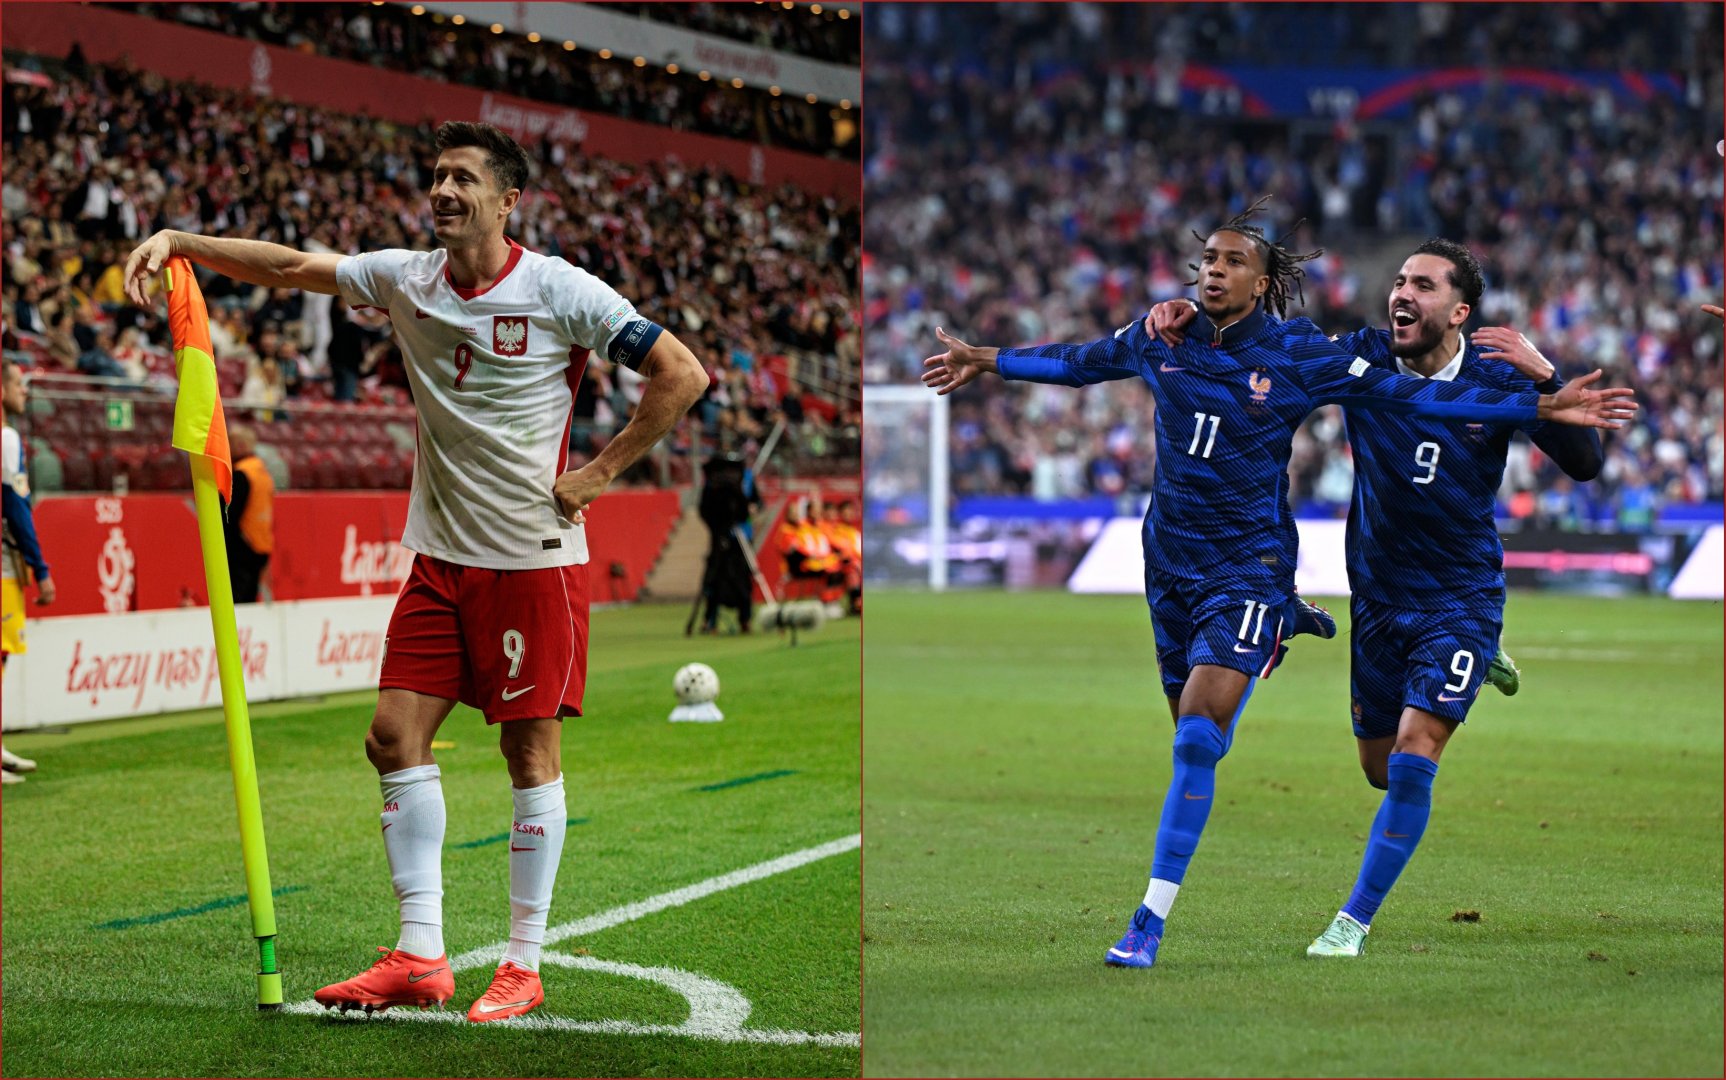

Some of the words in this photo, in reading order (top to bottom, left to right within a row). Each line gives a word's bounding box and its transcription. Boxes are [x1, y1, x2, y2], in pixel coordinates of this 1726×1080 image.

[454, 343, 473, 390] 9
[1188, 412, 1221, 459] 11
[1412, 441, 1441, 484] 9
[1238, 600, 1268, 645] 11
[66, 641, 151, 709] Łączy
[156, 647, 204, 690] nas
[502, 629, 525, 679] 9
[1444, 650, 1474, 693] 9
